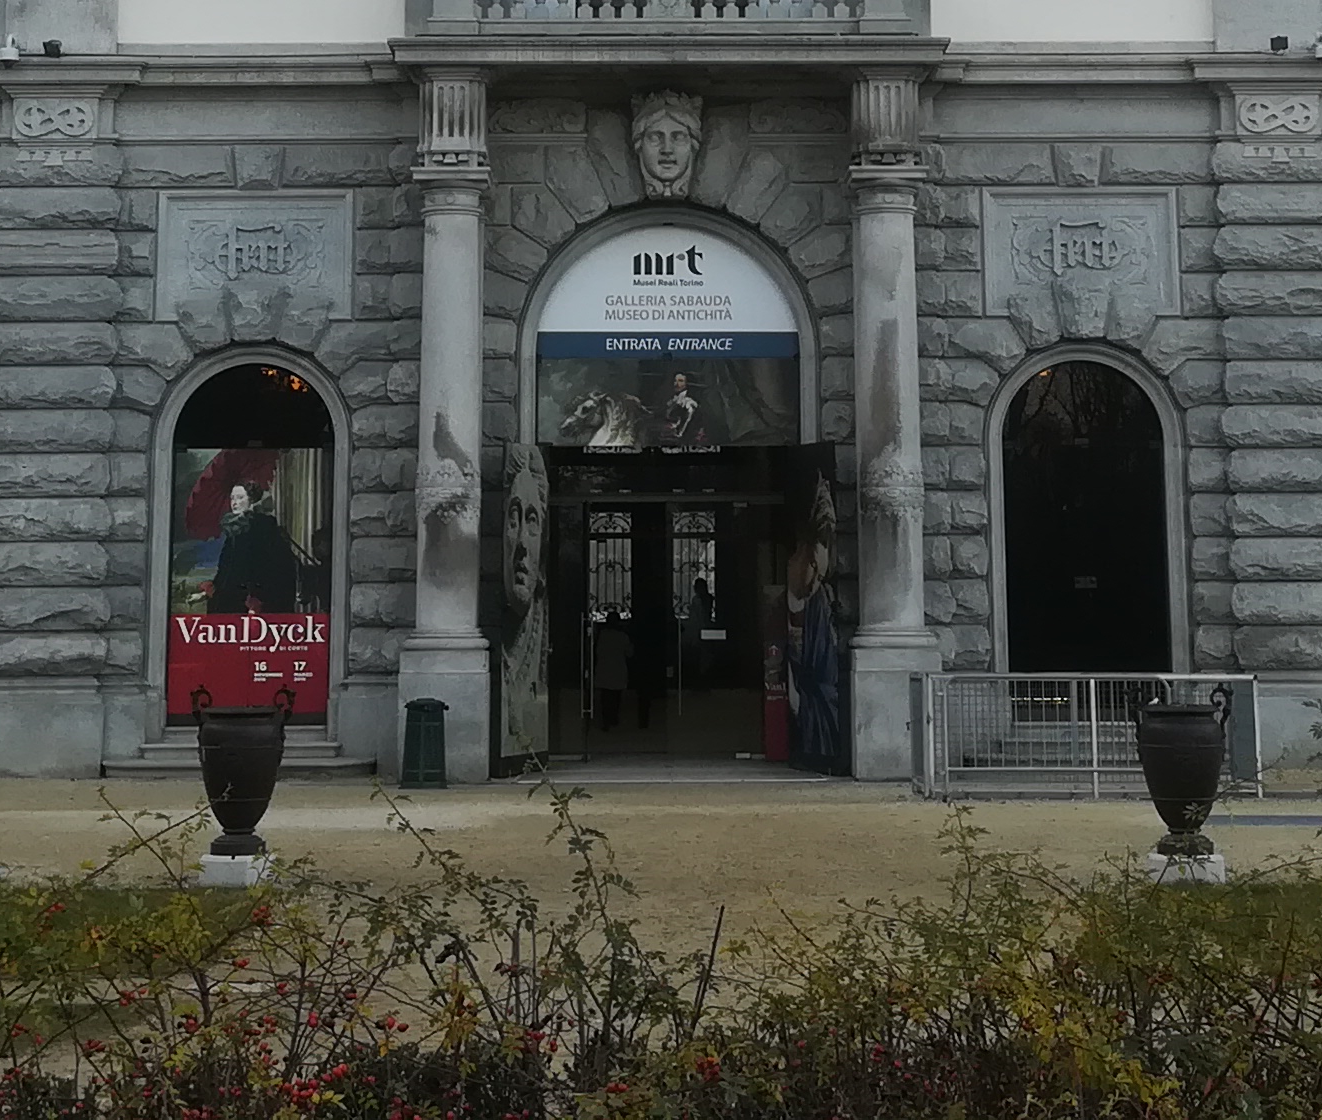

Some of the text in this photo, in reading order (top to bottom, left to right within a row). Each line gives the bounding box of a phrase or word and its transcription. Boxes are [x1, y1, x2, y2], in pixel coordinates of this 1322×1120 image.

[605, 295, 732, 306] GALLERIA SABAUDA
[605, 308, 733, 320] MUSEO DI ANTICHITÀ
[606, 338, 733, 350] ENTRATA ENTRANCE
[254, 661, 267, 671] 16
[293, 661, 307, 671] 17
